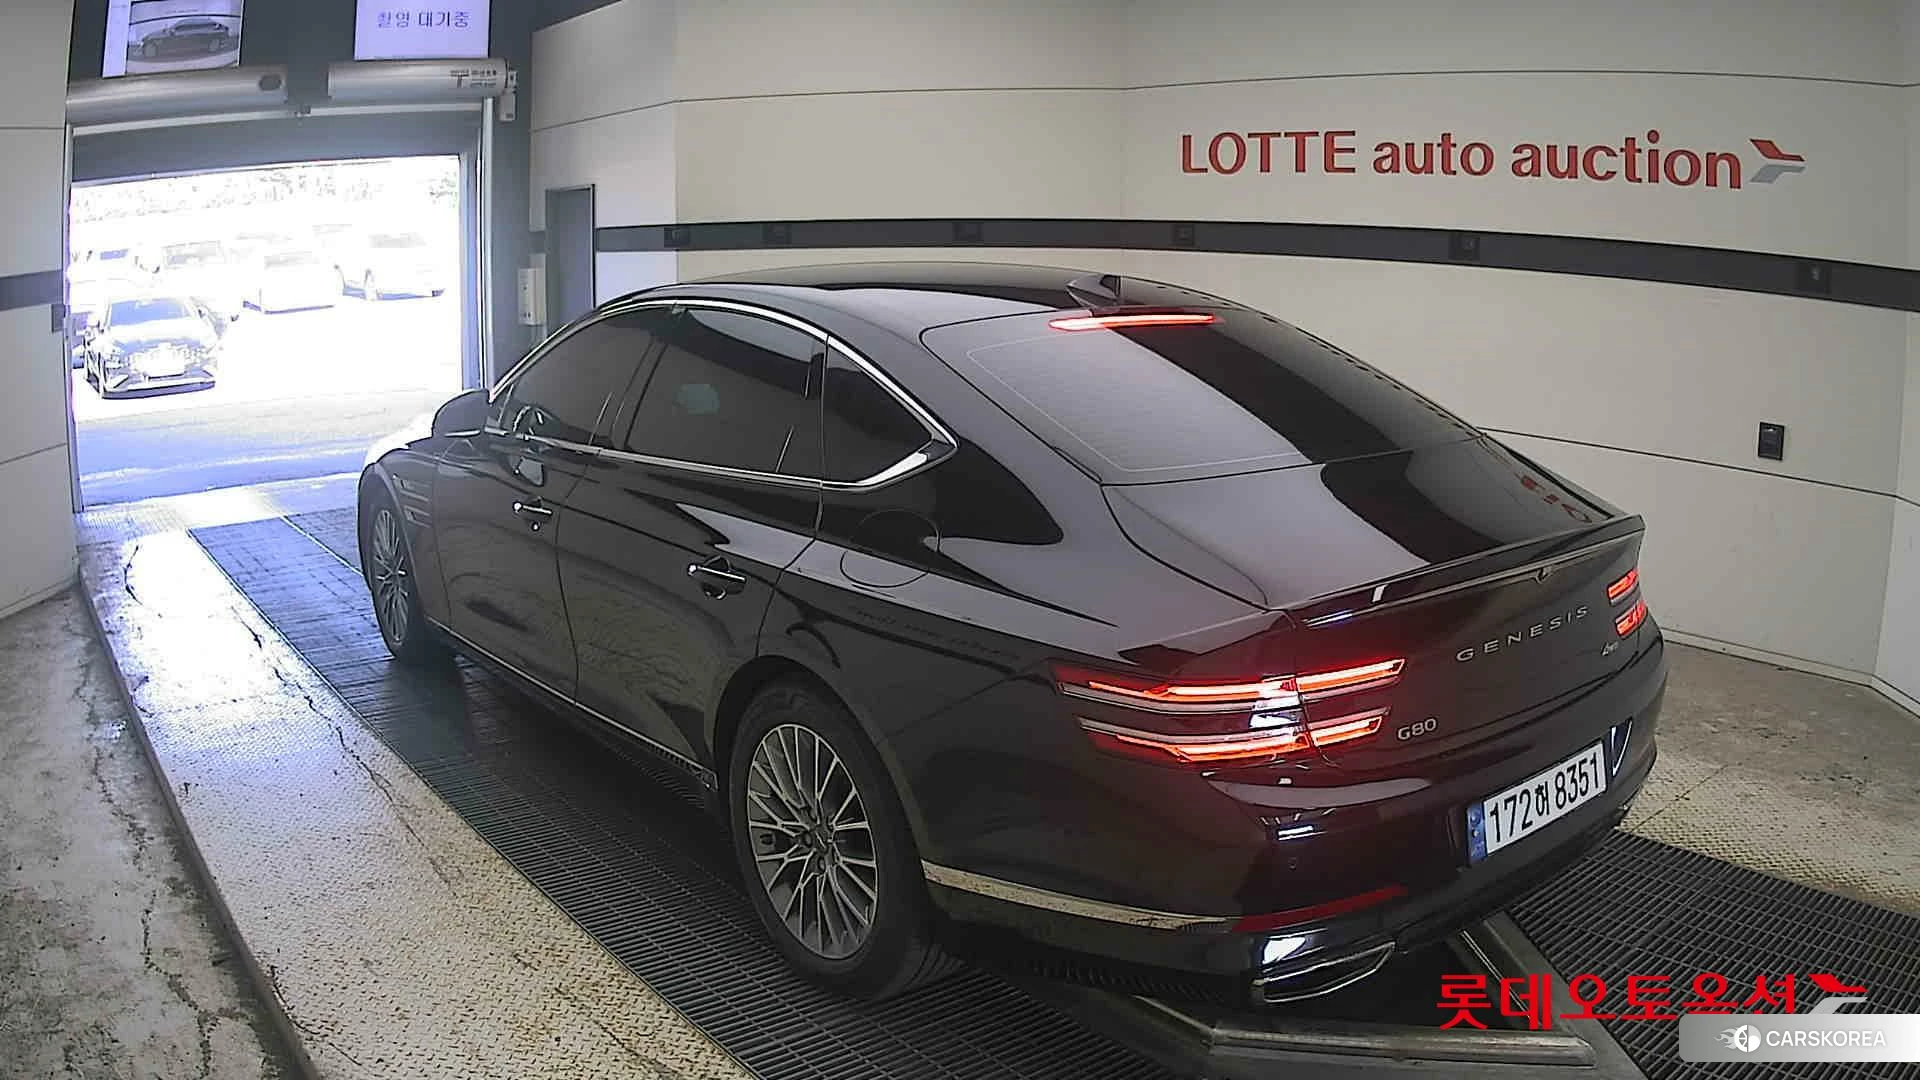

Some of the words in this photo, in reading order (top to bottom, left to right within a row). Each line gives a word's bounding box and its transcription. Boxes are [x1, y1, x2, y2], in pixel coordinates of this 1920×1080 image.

[418, 11, 468, 28] 대기중
[1182, 130, 1357, 175] LOTTE
[1373, 132, 1495, 177] auto
[1512, 130, 1742, 190] auction
[1456, 605, 1589, 662] GENESIS
[1397, 717, 1438, 741] G80
[1489, 780, 1550, 843] 172허
[1554, 751, 1599, 810] 8351
